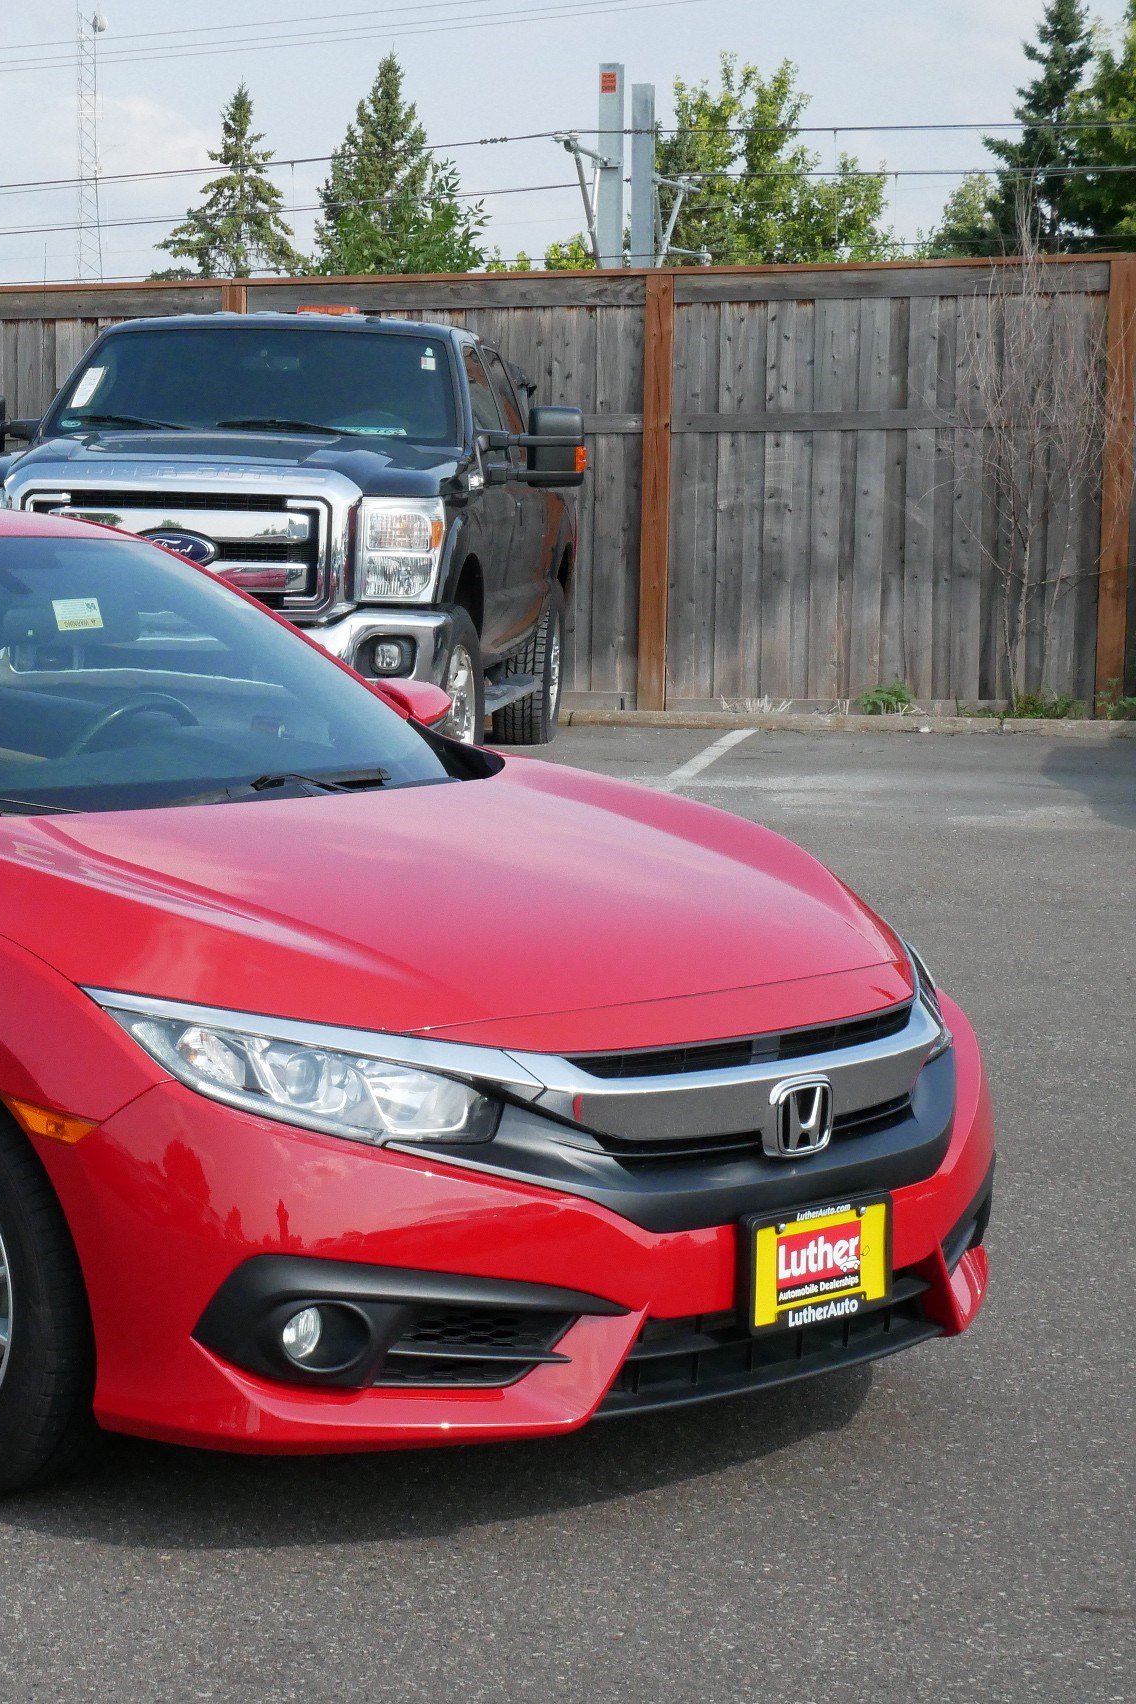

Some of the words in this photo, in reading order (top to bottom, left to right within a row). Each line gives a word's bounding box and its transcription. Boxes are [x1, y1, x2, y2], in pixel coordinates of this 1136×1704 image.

[796, 1203, 851, 1222] LutherAuto.com
[778, 1235, 860, 1280] Luther
[778, 1283, 819, 1302] Automobile
[819, 1275, 859, 1292] Dealerships
[788, 1297, 859, 1328] LutherAuto
